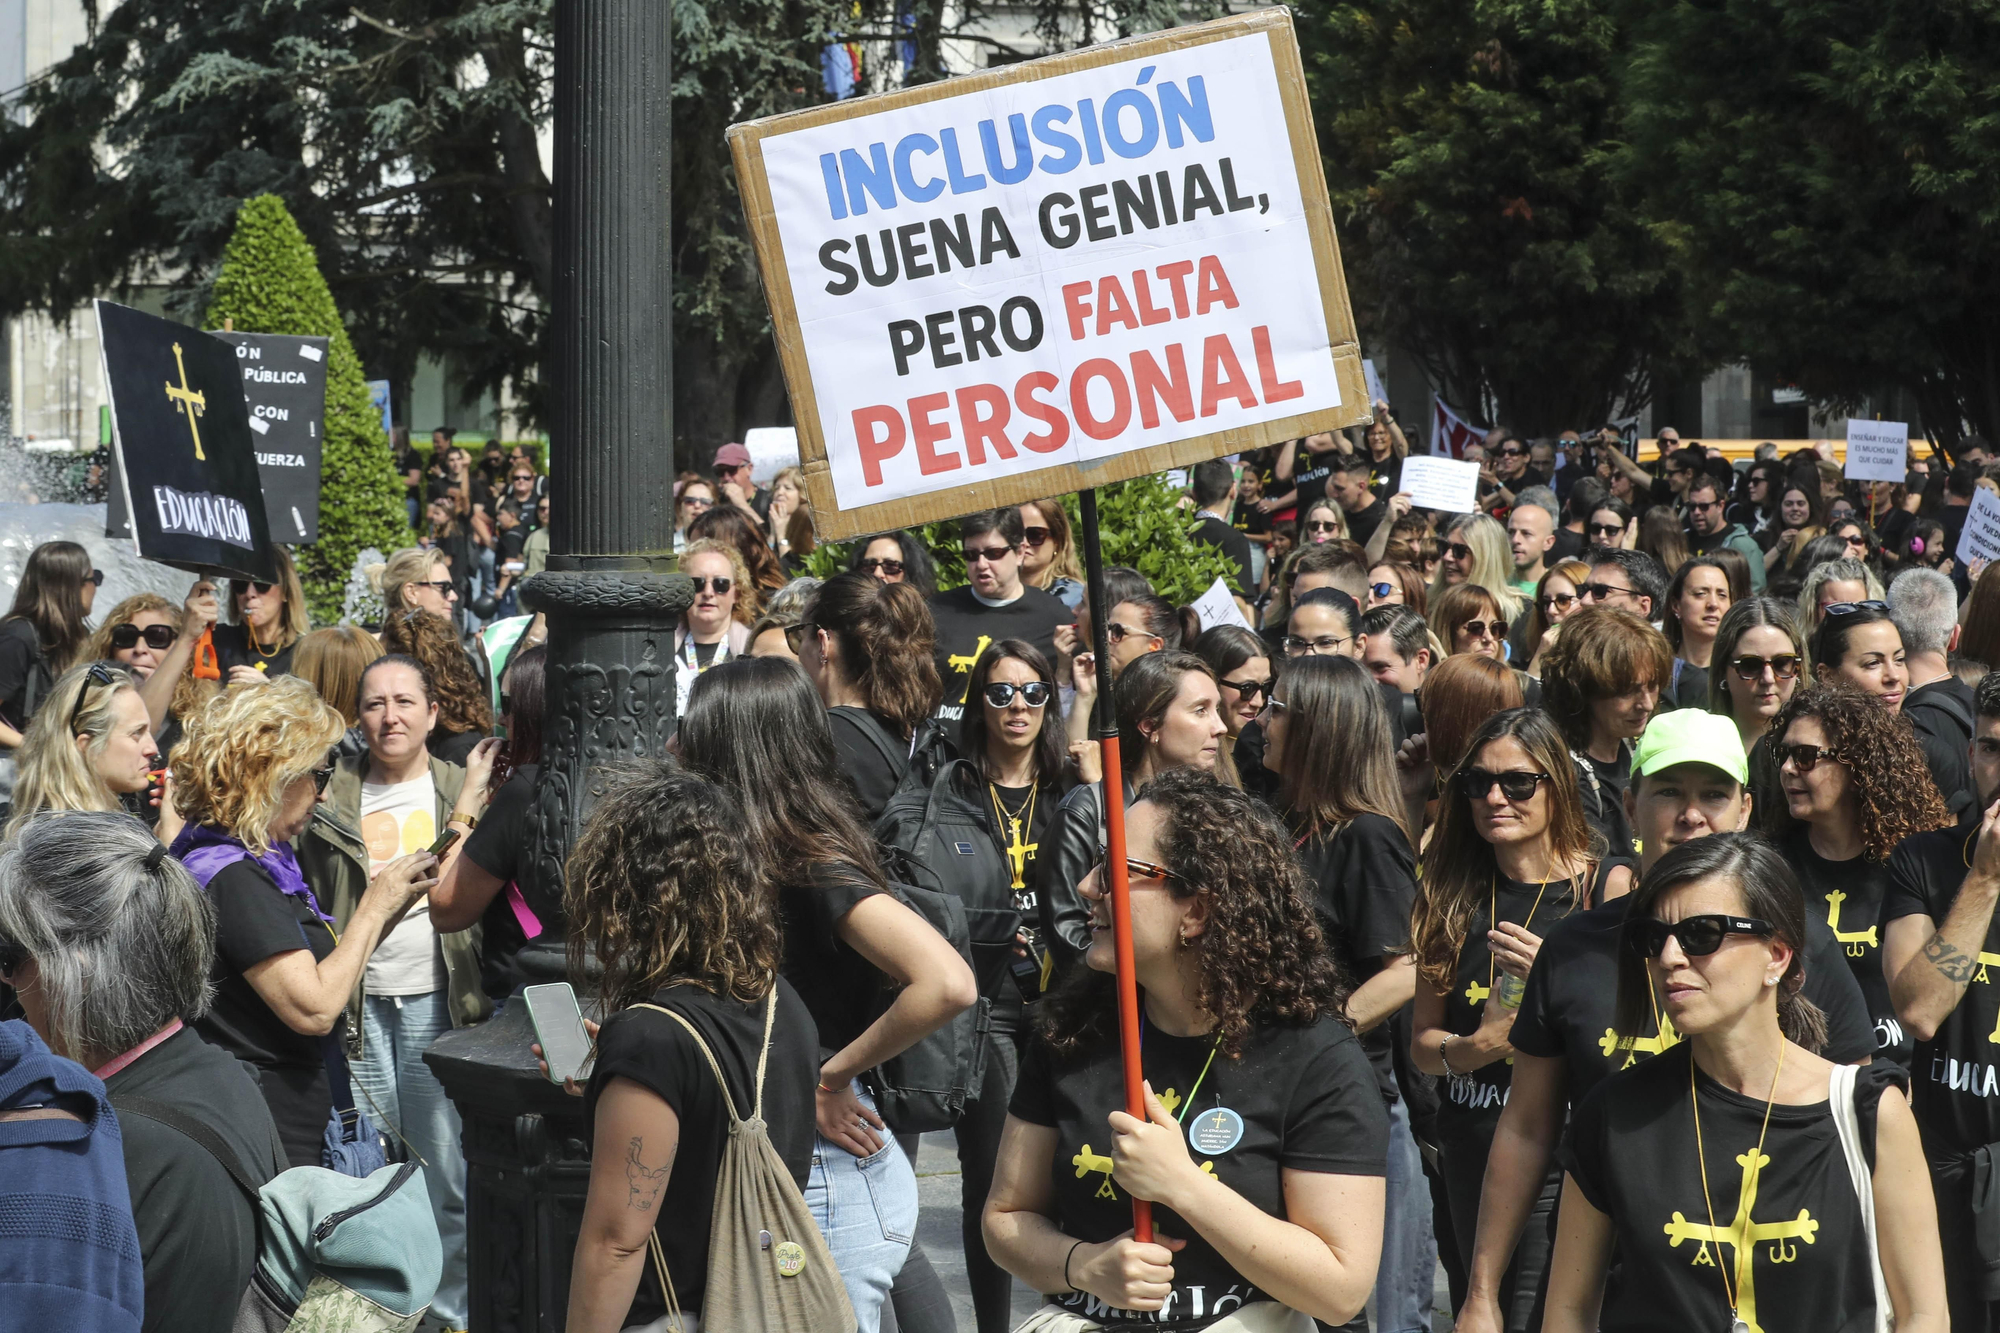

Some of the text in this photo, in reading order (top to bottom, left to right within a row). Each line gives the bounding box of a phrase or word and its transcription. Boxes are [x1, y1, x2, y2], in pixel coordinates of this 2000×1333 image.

[819, 65, 1215, 220] INCLUSIÓN
[818, 157, 1271, 296] SUENA GENIAL,
[888, 254, 1240, 376] PERO FALTA
[244, 366, 307, 384] PÚBLICA
[254, 405, 289, 421] CON
[851, 325, 1304, 488] PERSONAL
[1850, 433, 1877, 442] ENSEÑAR
[1882, 436, 1904, 444] EDUCAR
[1862, 445, 1885, 454] MUCHO
[1886, 446, 1899, 455] MÁS
[254, 452, 306, 467] UERZA
[1872, 457, 1893, 465] CUIDAR
[153, 488, 251, 542] EDUCACIÓN
[1984, 507, 1991, 518] LA
[785, 1260, 798, 1269] 10
